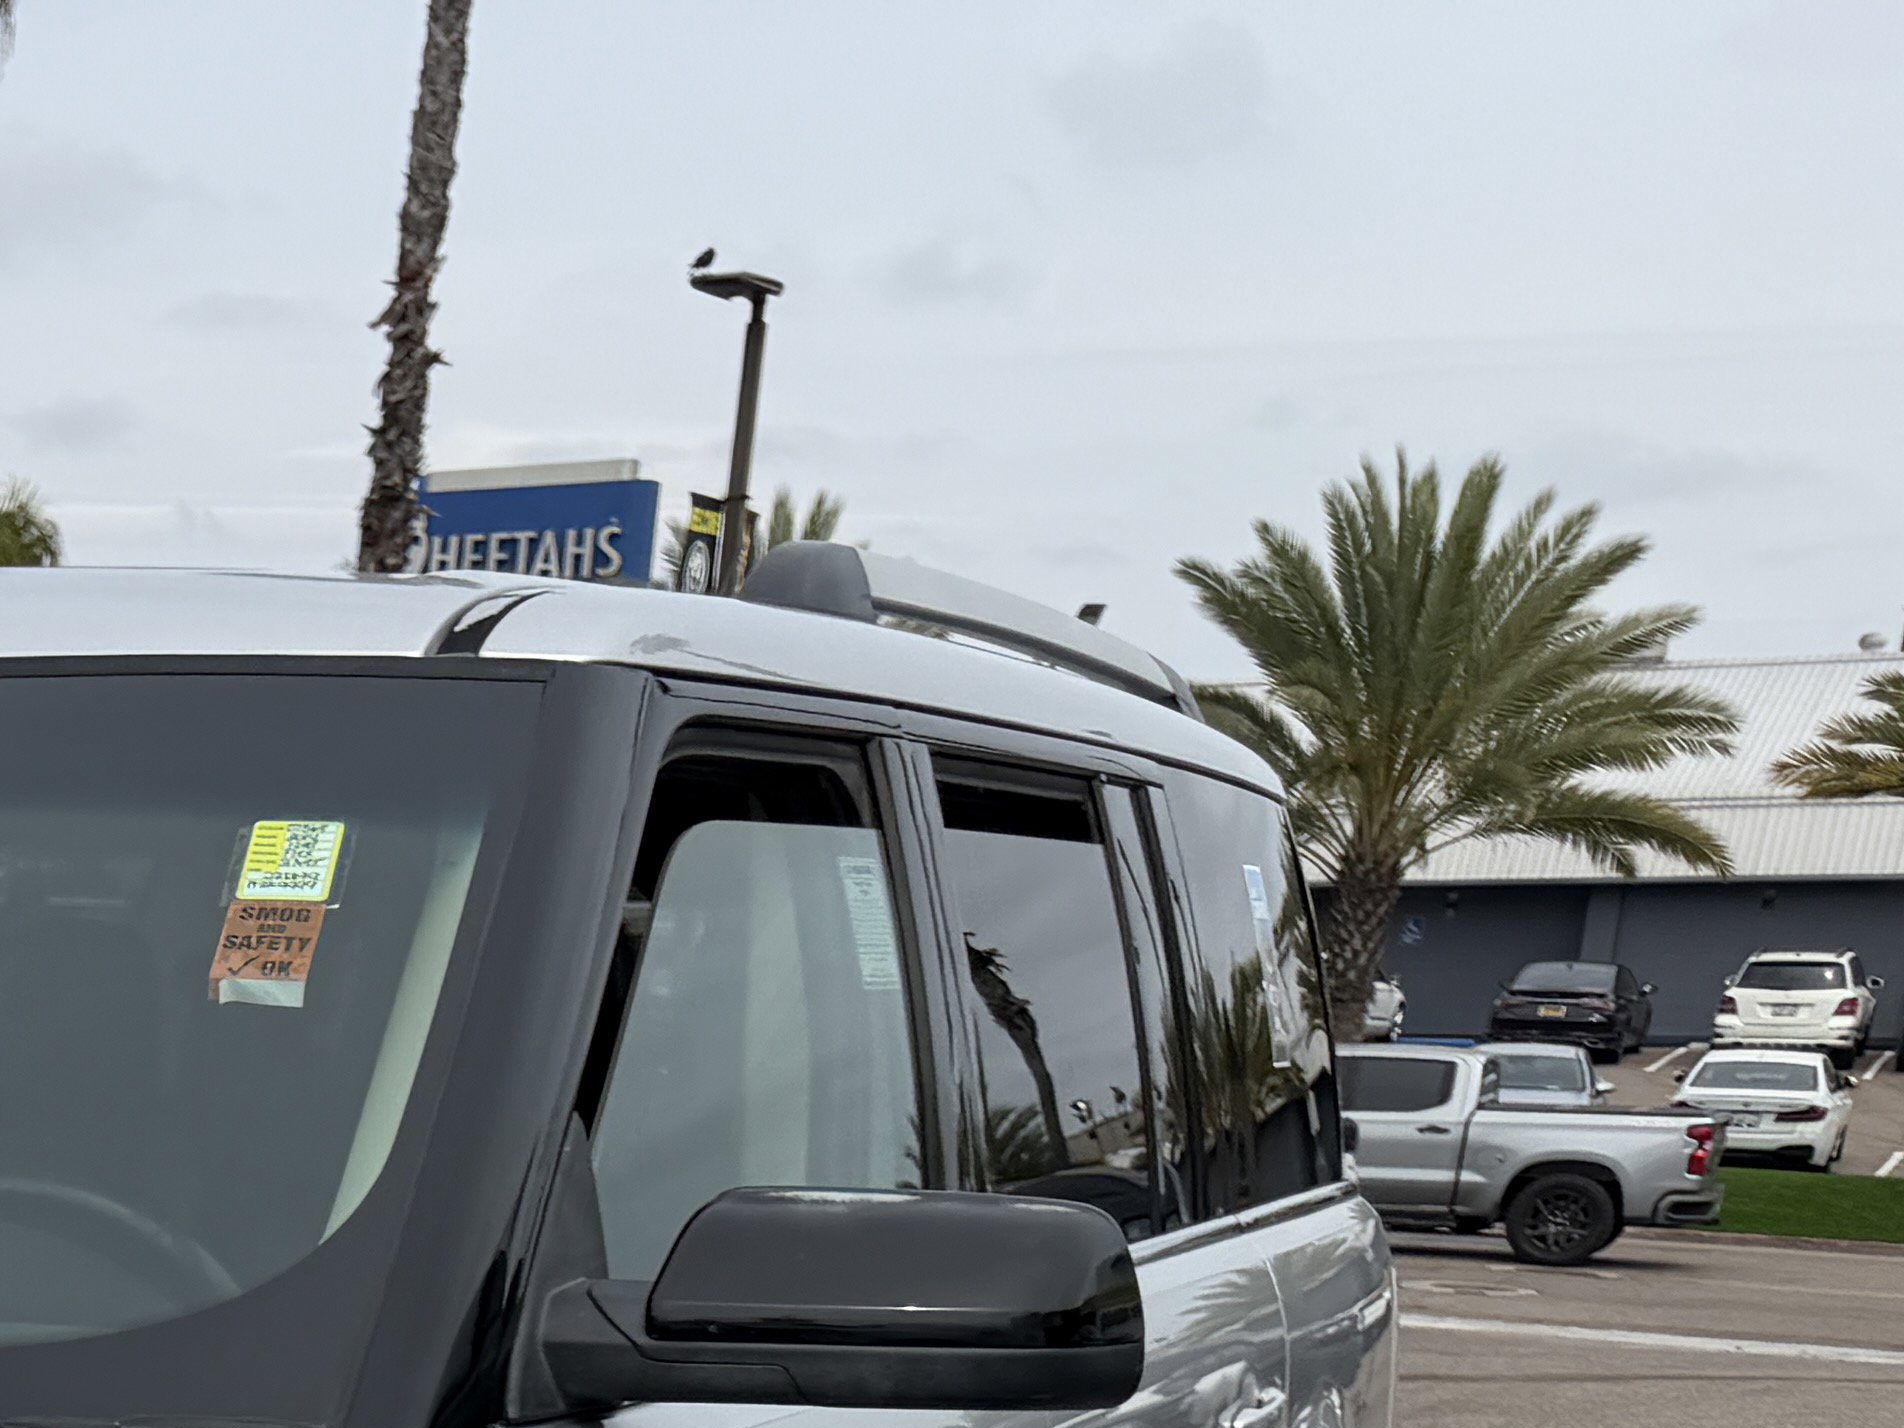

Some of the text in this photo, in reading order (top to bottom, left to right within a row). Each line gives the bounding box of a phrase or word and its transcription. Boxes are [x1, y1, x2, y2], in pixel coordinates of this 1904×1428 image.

[239, 906, 311, 923] SMOG
[222, 934, 312, 952] SAFETY
[260, 960, 294, 977] OK
